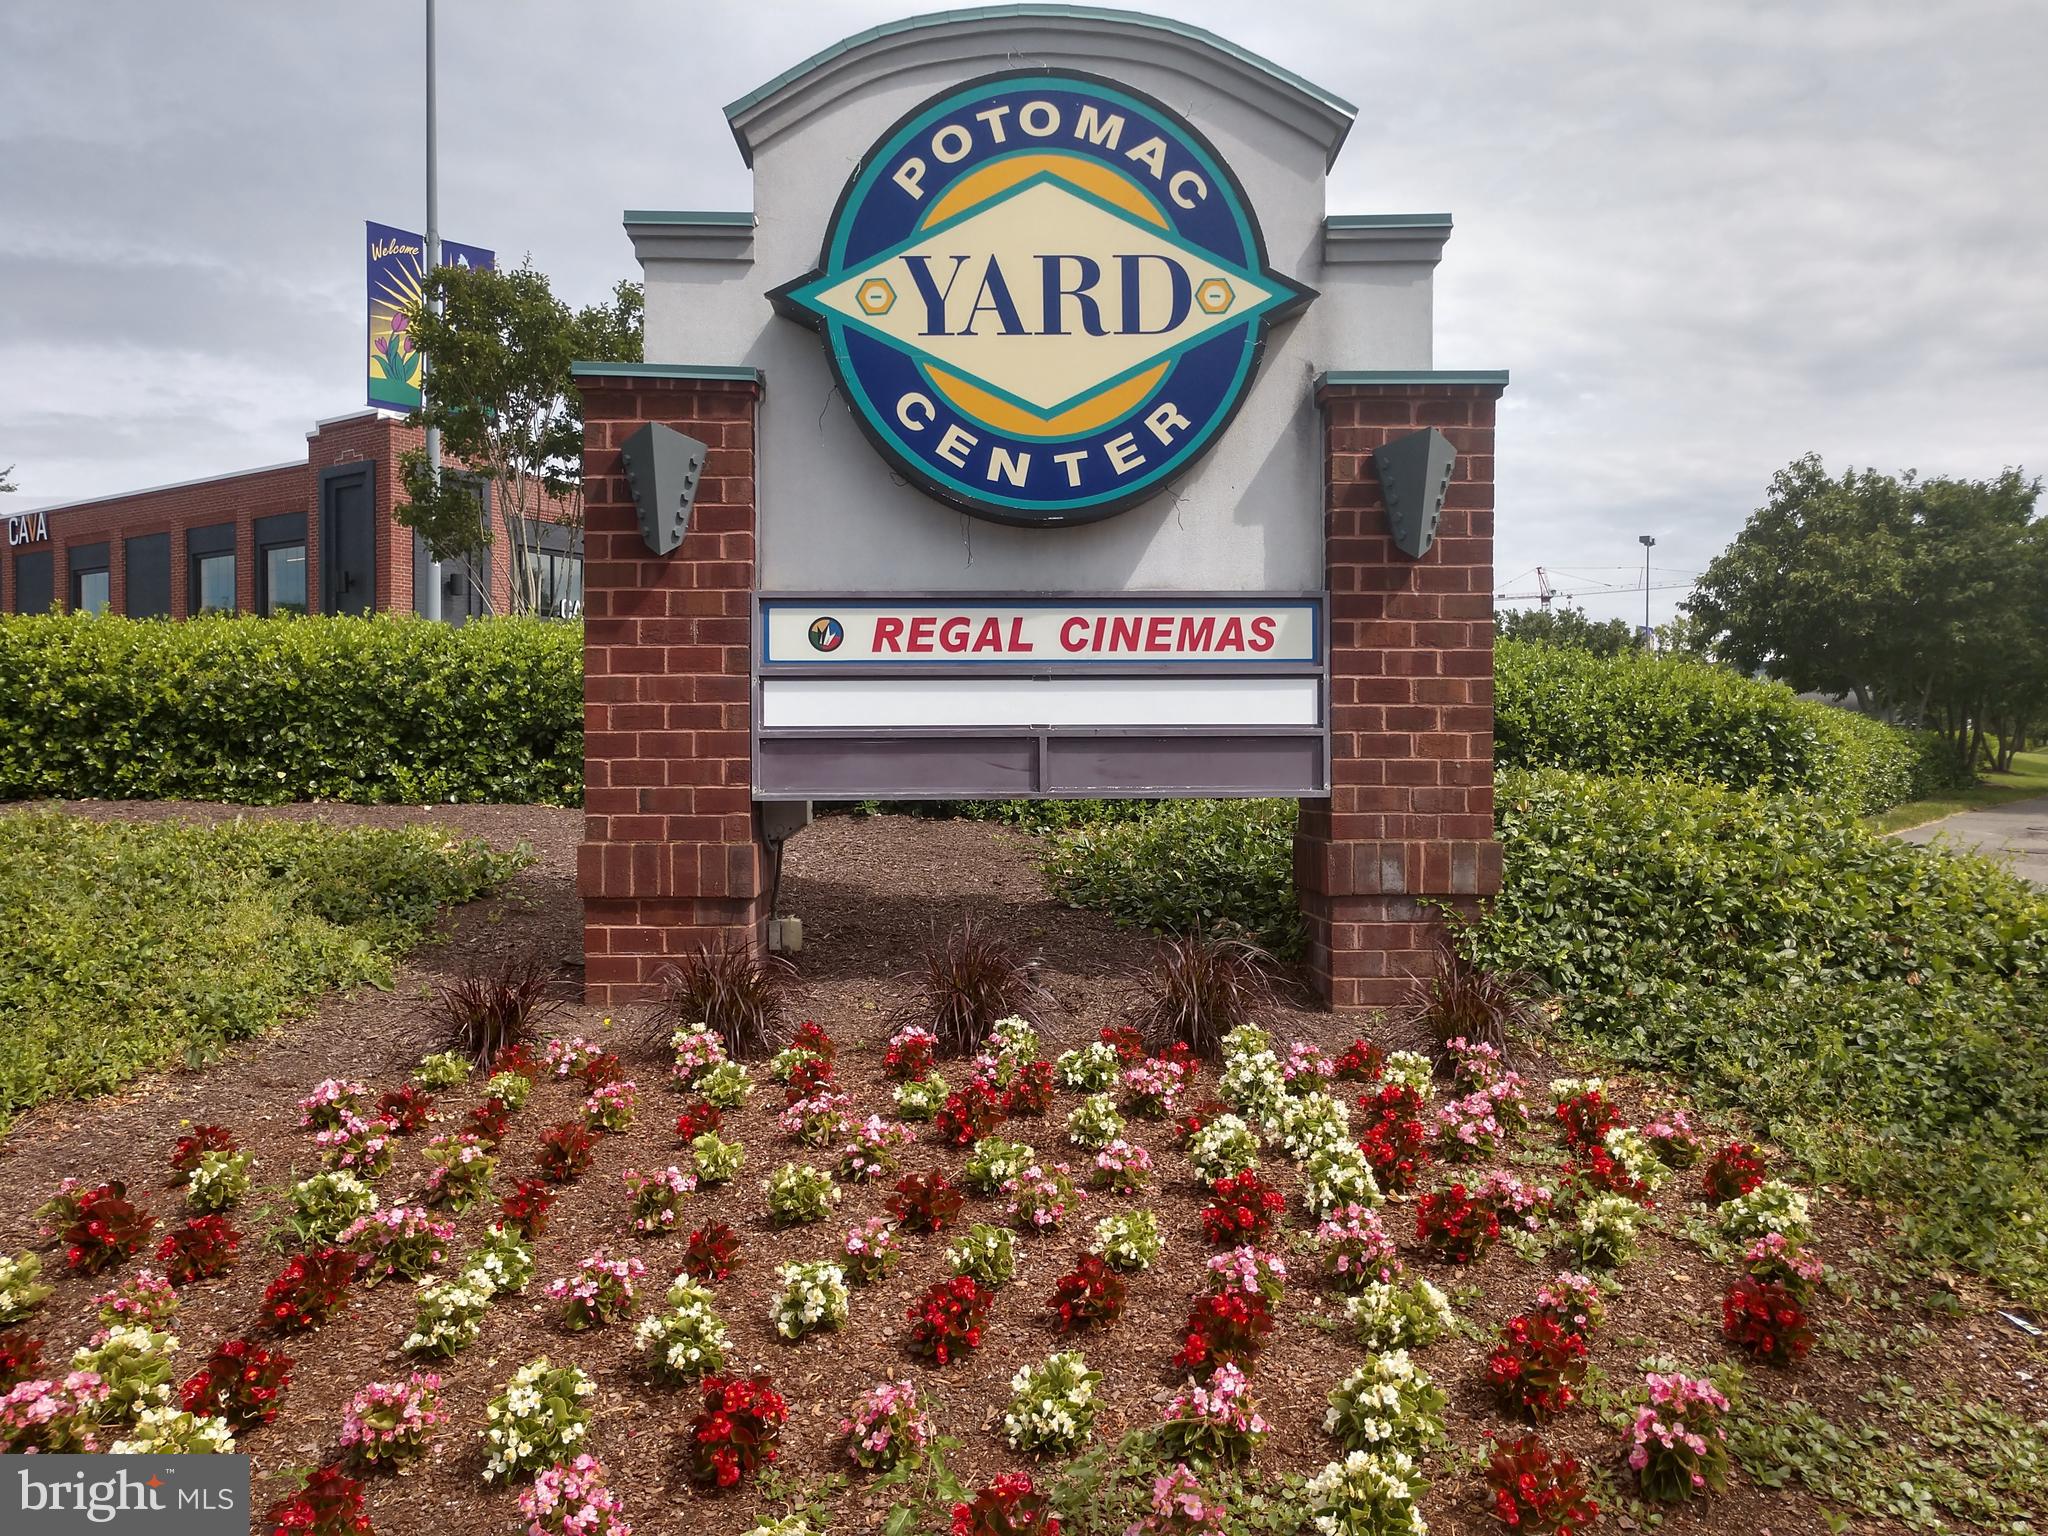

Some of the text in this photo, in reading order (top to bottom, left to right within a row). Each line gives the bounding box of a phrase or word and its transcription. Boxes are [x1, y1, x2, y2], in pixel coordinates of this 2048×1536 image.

[893, 101, 1207, 209] POTOMAC
[371, 238, 420, 261] Welcome
[899, 253, 1192, 337] YARD
[896, 391, 1191, 487] CENTER
[8, 512, 48, 546] CAVA
[871, 616, 1276, 653] REGAL CINEMAS
